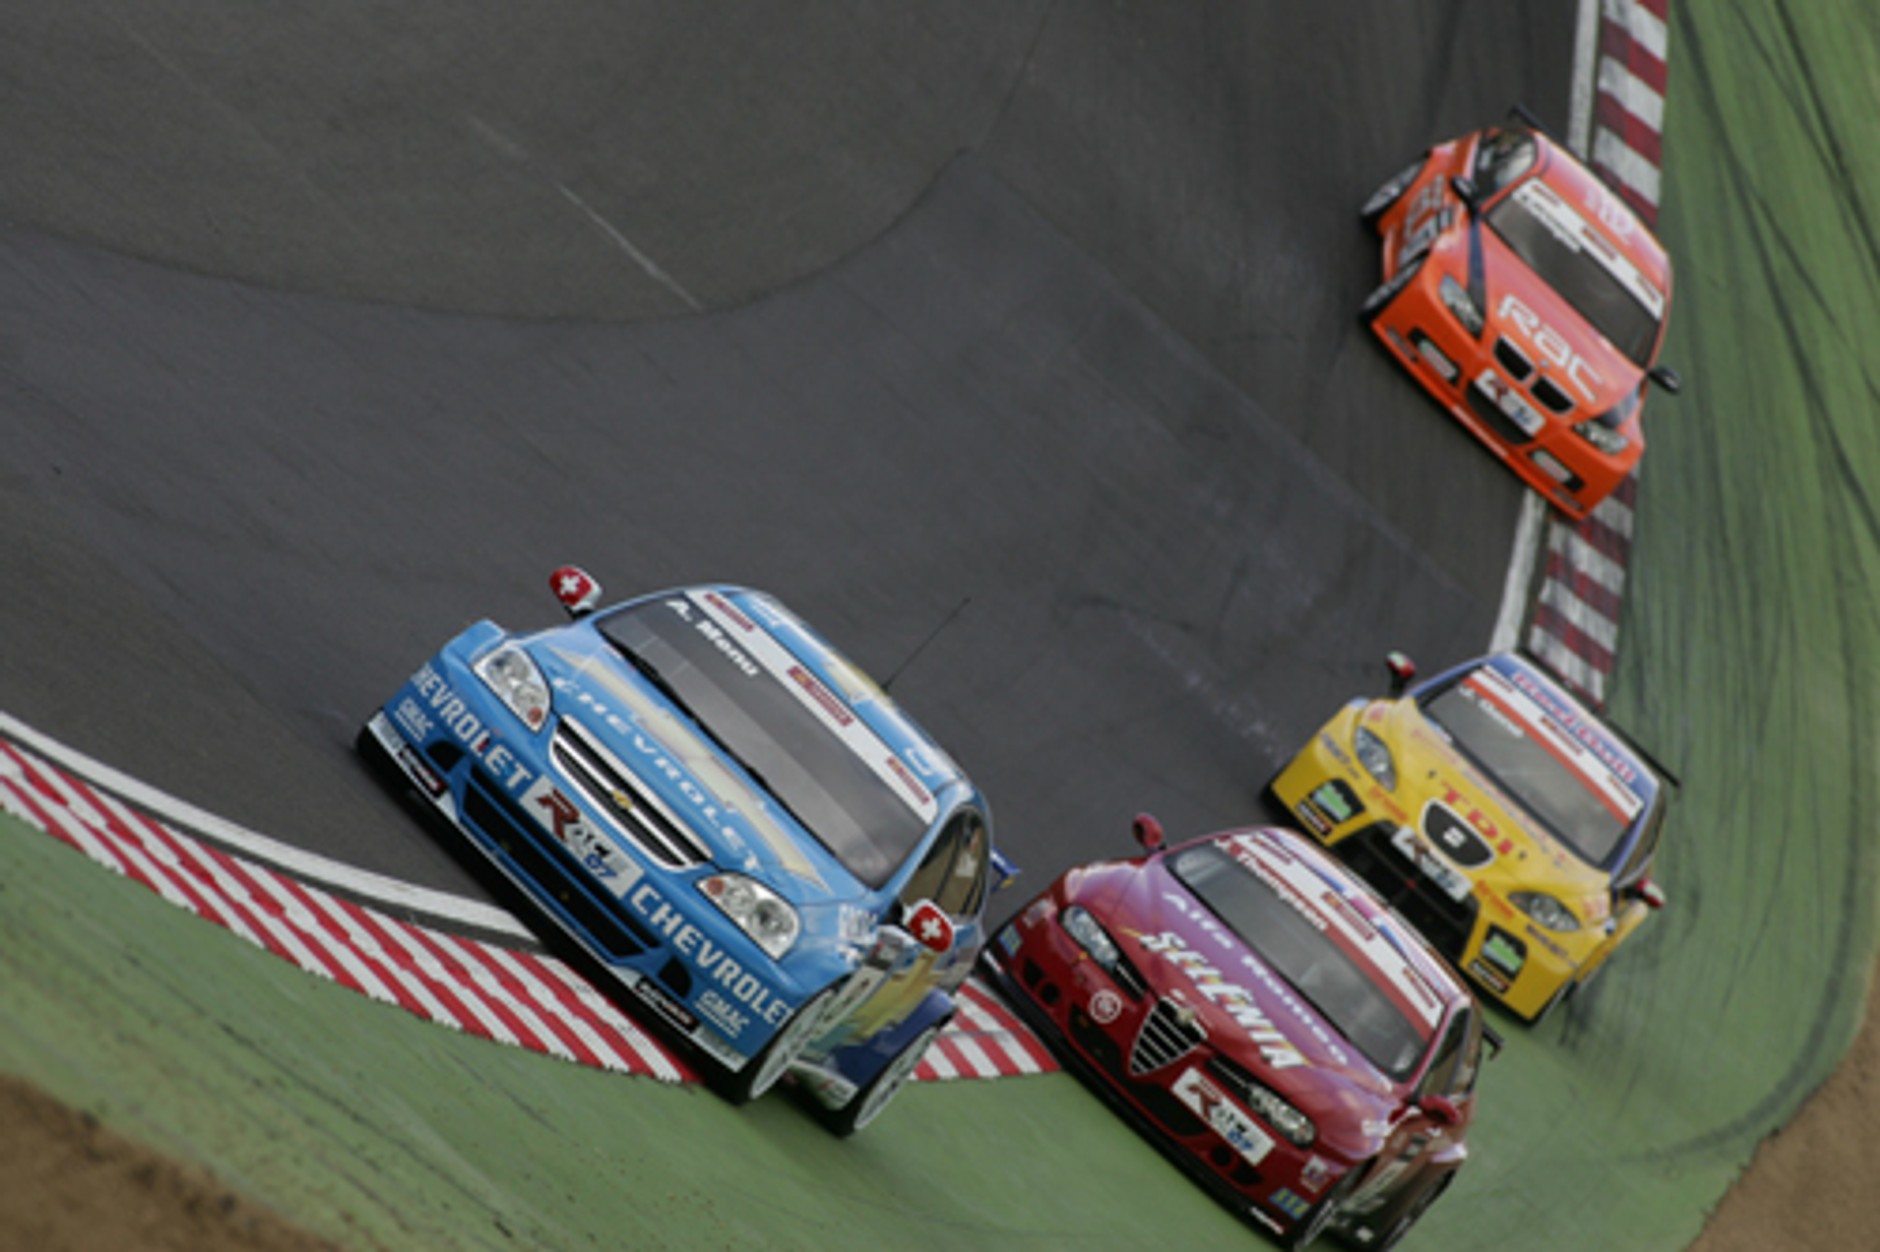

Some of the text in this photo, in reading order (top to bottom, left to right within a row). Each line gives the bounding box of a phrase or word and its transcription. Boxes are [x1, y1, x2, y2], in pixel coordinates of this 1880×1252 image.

[695, 619, 759, 677] Menu
[552, 676, 765, 884] CHEVROLET
[1441, 781, 1514, 857] TDI
[1139, 931, 1304, 1068] SELENIA
